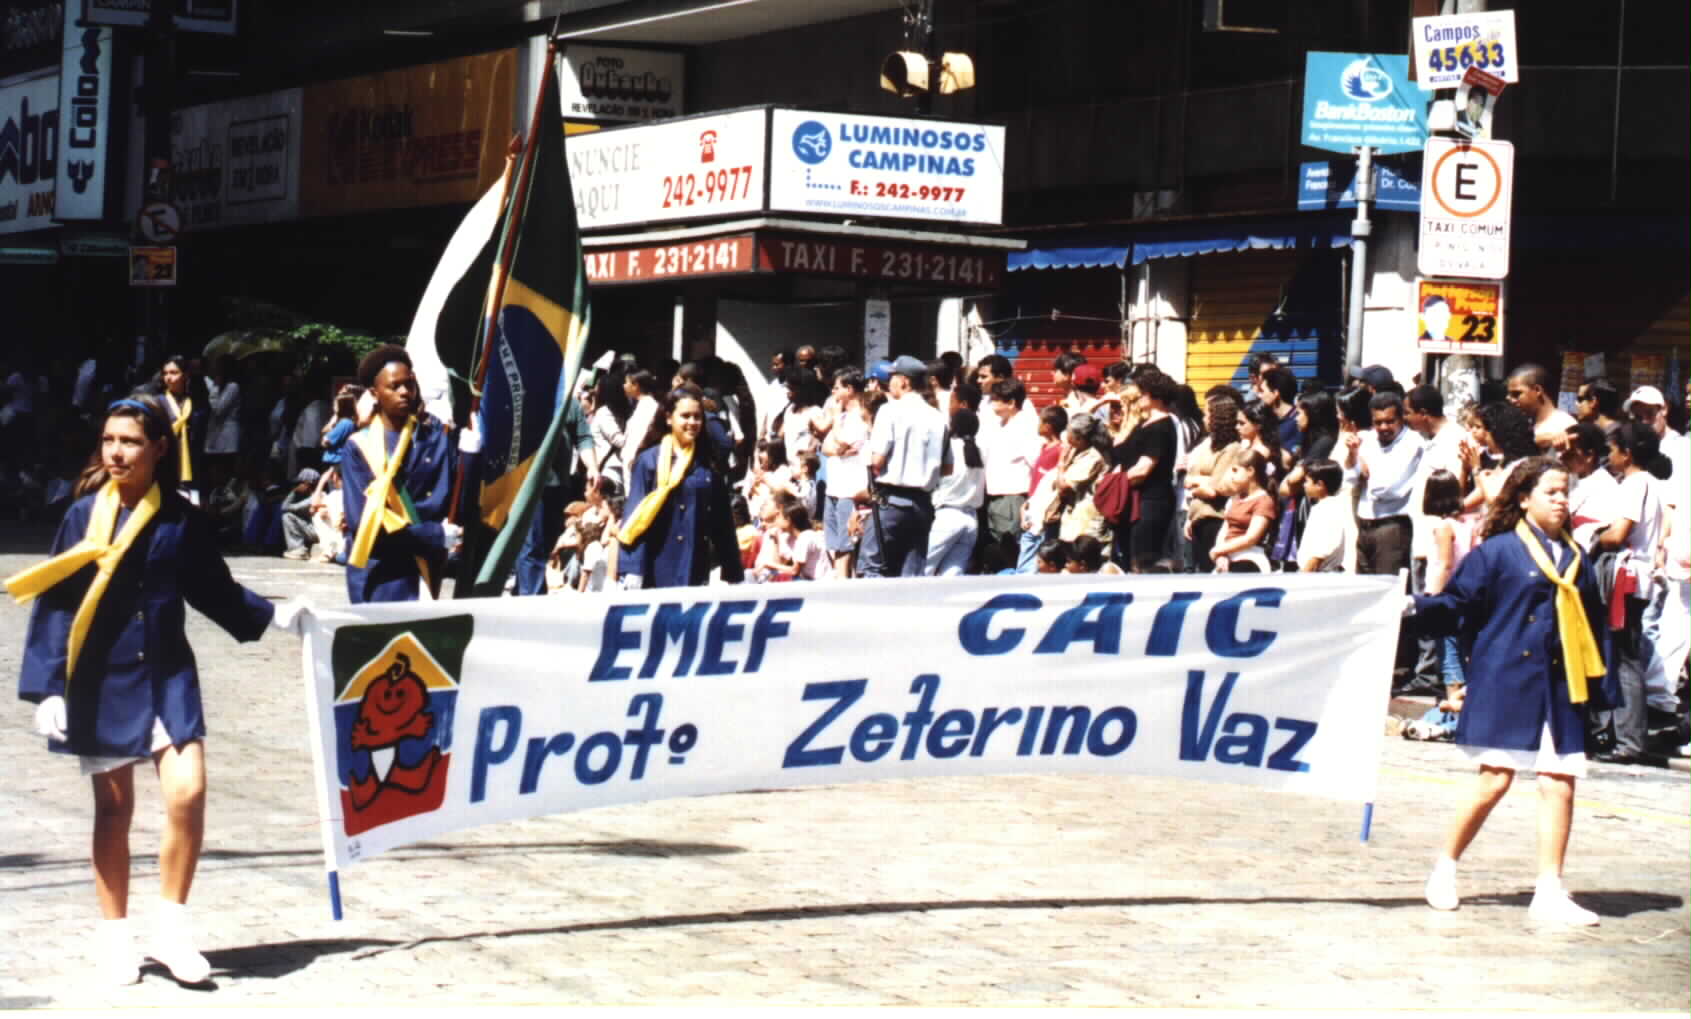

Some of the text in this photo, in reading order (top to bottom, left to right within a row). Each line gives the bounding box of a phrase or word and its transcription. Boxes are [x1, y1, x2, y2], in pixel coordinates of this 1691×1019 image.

[1424, 24, 1480, 43] Campos
[1428, 42, 1506, 72] 45633
[840, 123, 986, 153] LUMINOSOS
[570, 144, 641, 179] NUNCIE
[848, 150, 976, 177] CAMPINAS
[876, 183, 966, 203] 242-9977
[1455, 163, 1479, 200] E
[575, 184, 620, 218] AQUI
[1427, 221, 1504, 236] TAXI COMUM
[586, 253, 616, 278] AXI
[782, 241, 836, 271] TAXI
[1460, 315, 1496, 343] 23
[588, 587, 1287, 682] EMEF CAIC
[781, 673, 1137, 769] Zeferino
[1179, 670, 1318, 773] Vaz
